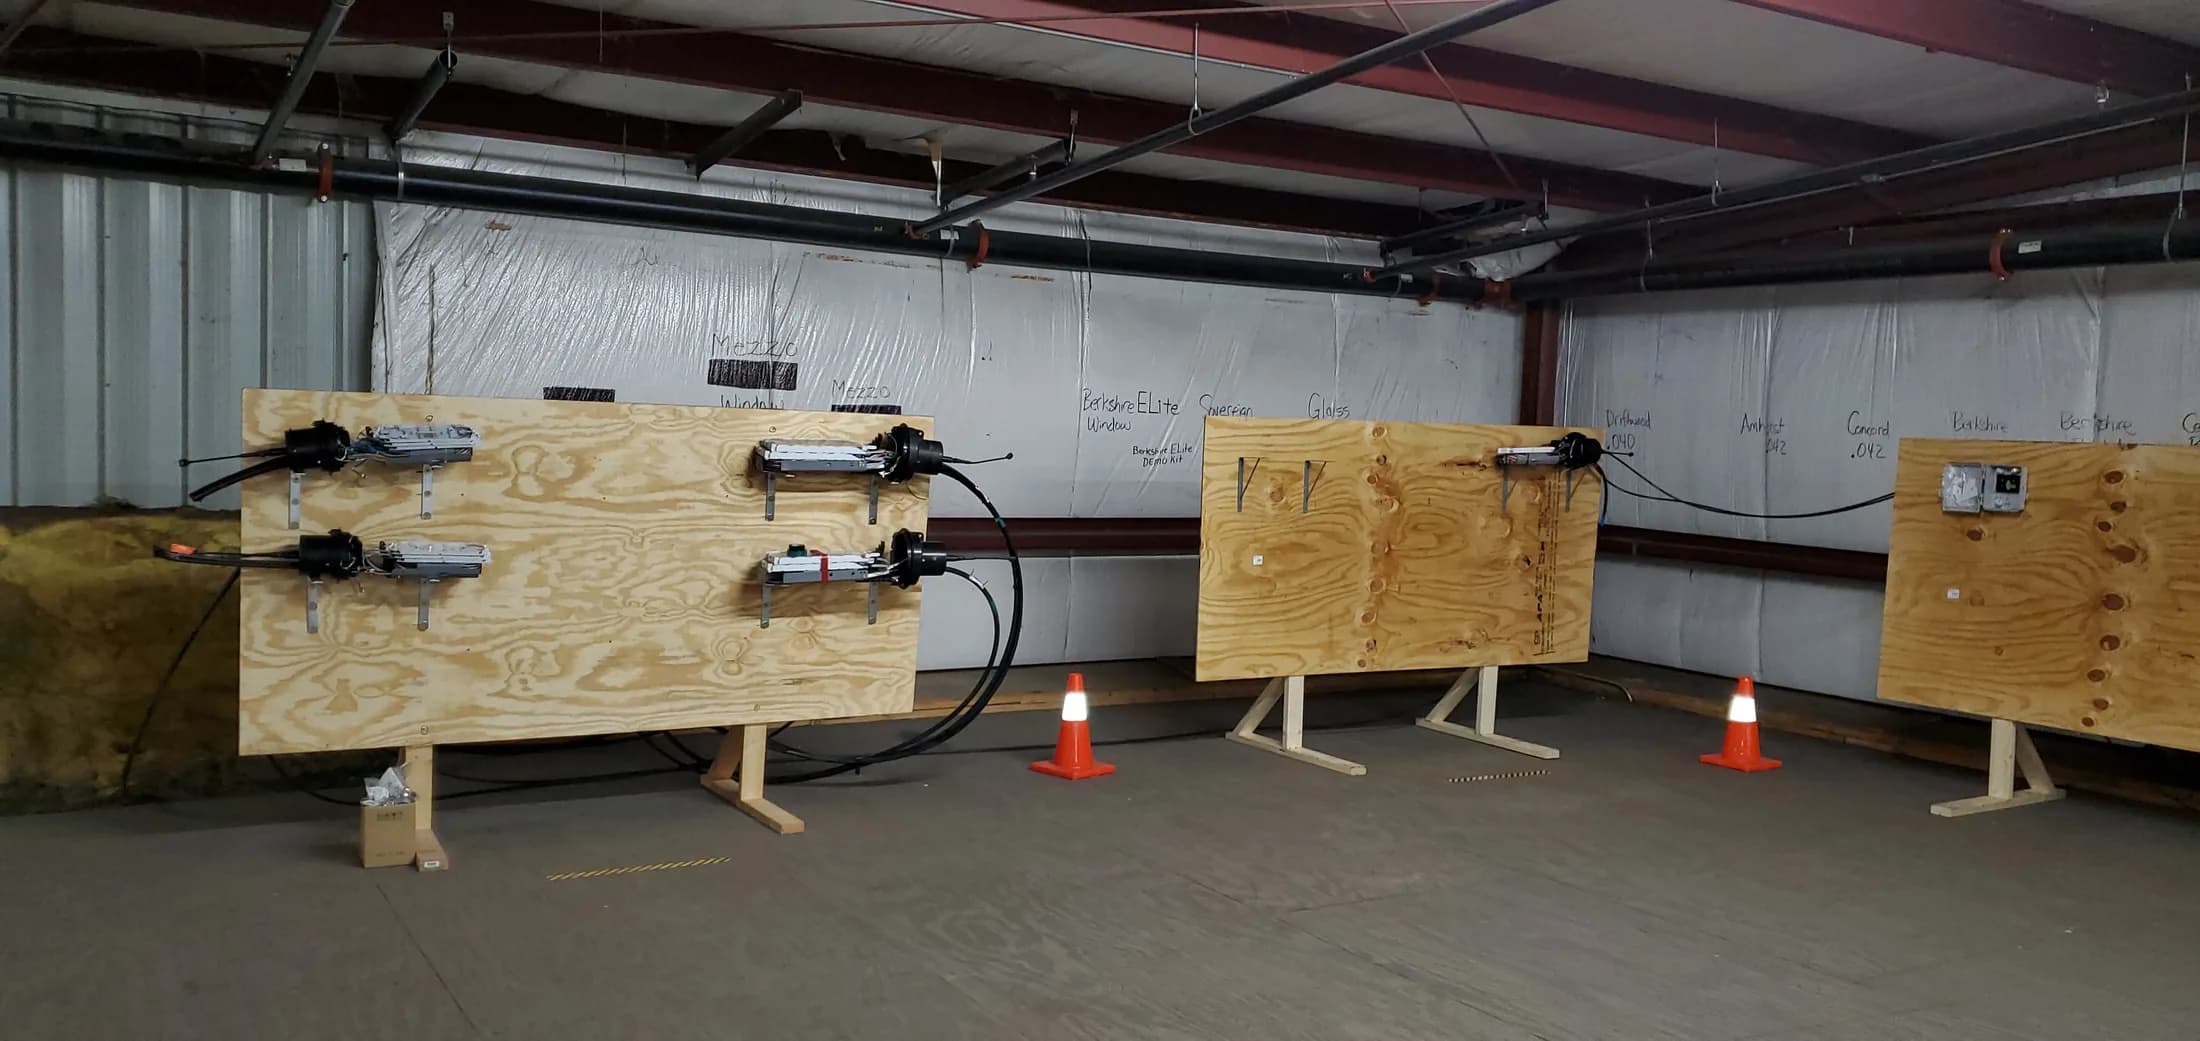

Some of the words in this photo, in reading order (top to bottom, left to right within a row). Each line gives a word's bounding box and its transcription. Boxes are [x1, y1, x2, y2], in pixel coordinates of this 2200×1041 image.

[711, 333, 799, 358] Mezzo
[831, 379, 891, 399] Mezzo
[1082, 388, 1136, 414] Berkshire
[1087, 415, 1132, 432] Window
[1848, 410, 1890, 437] Concord
[1850, 443, 1887, 459] .042
